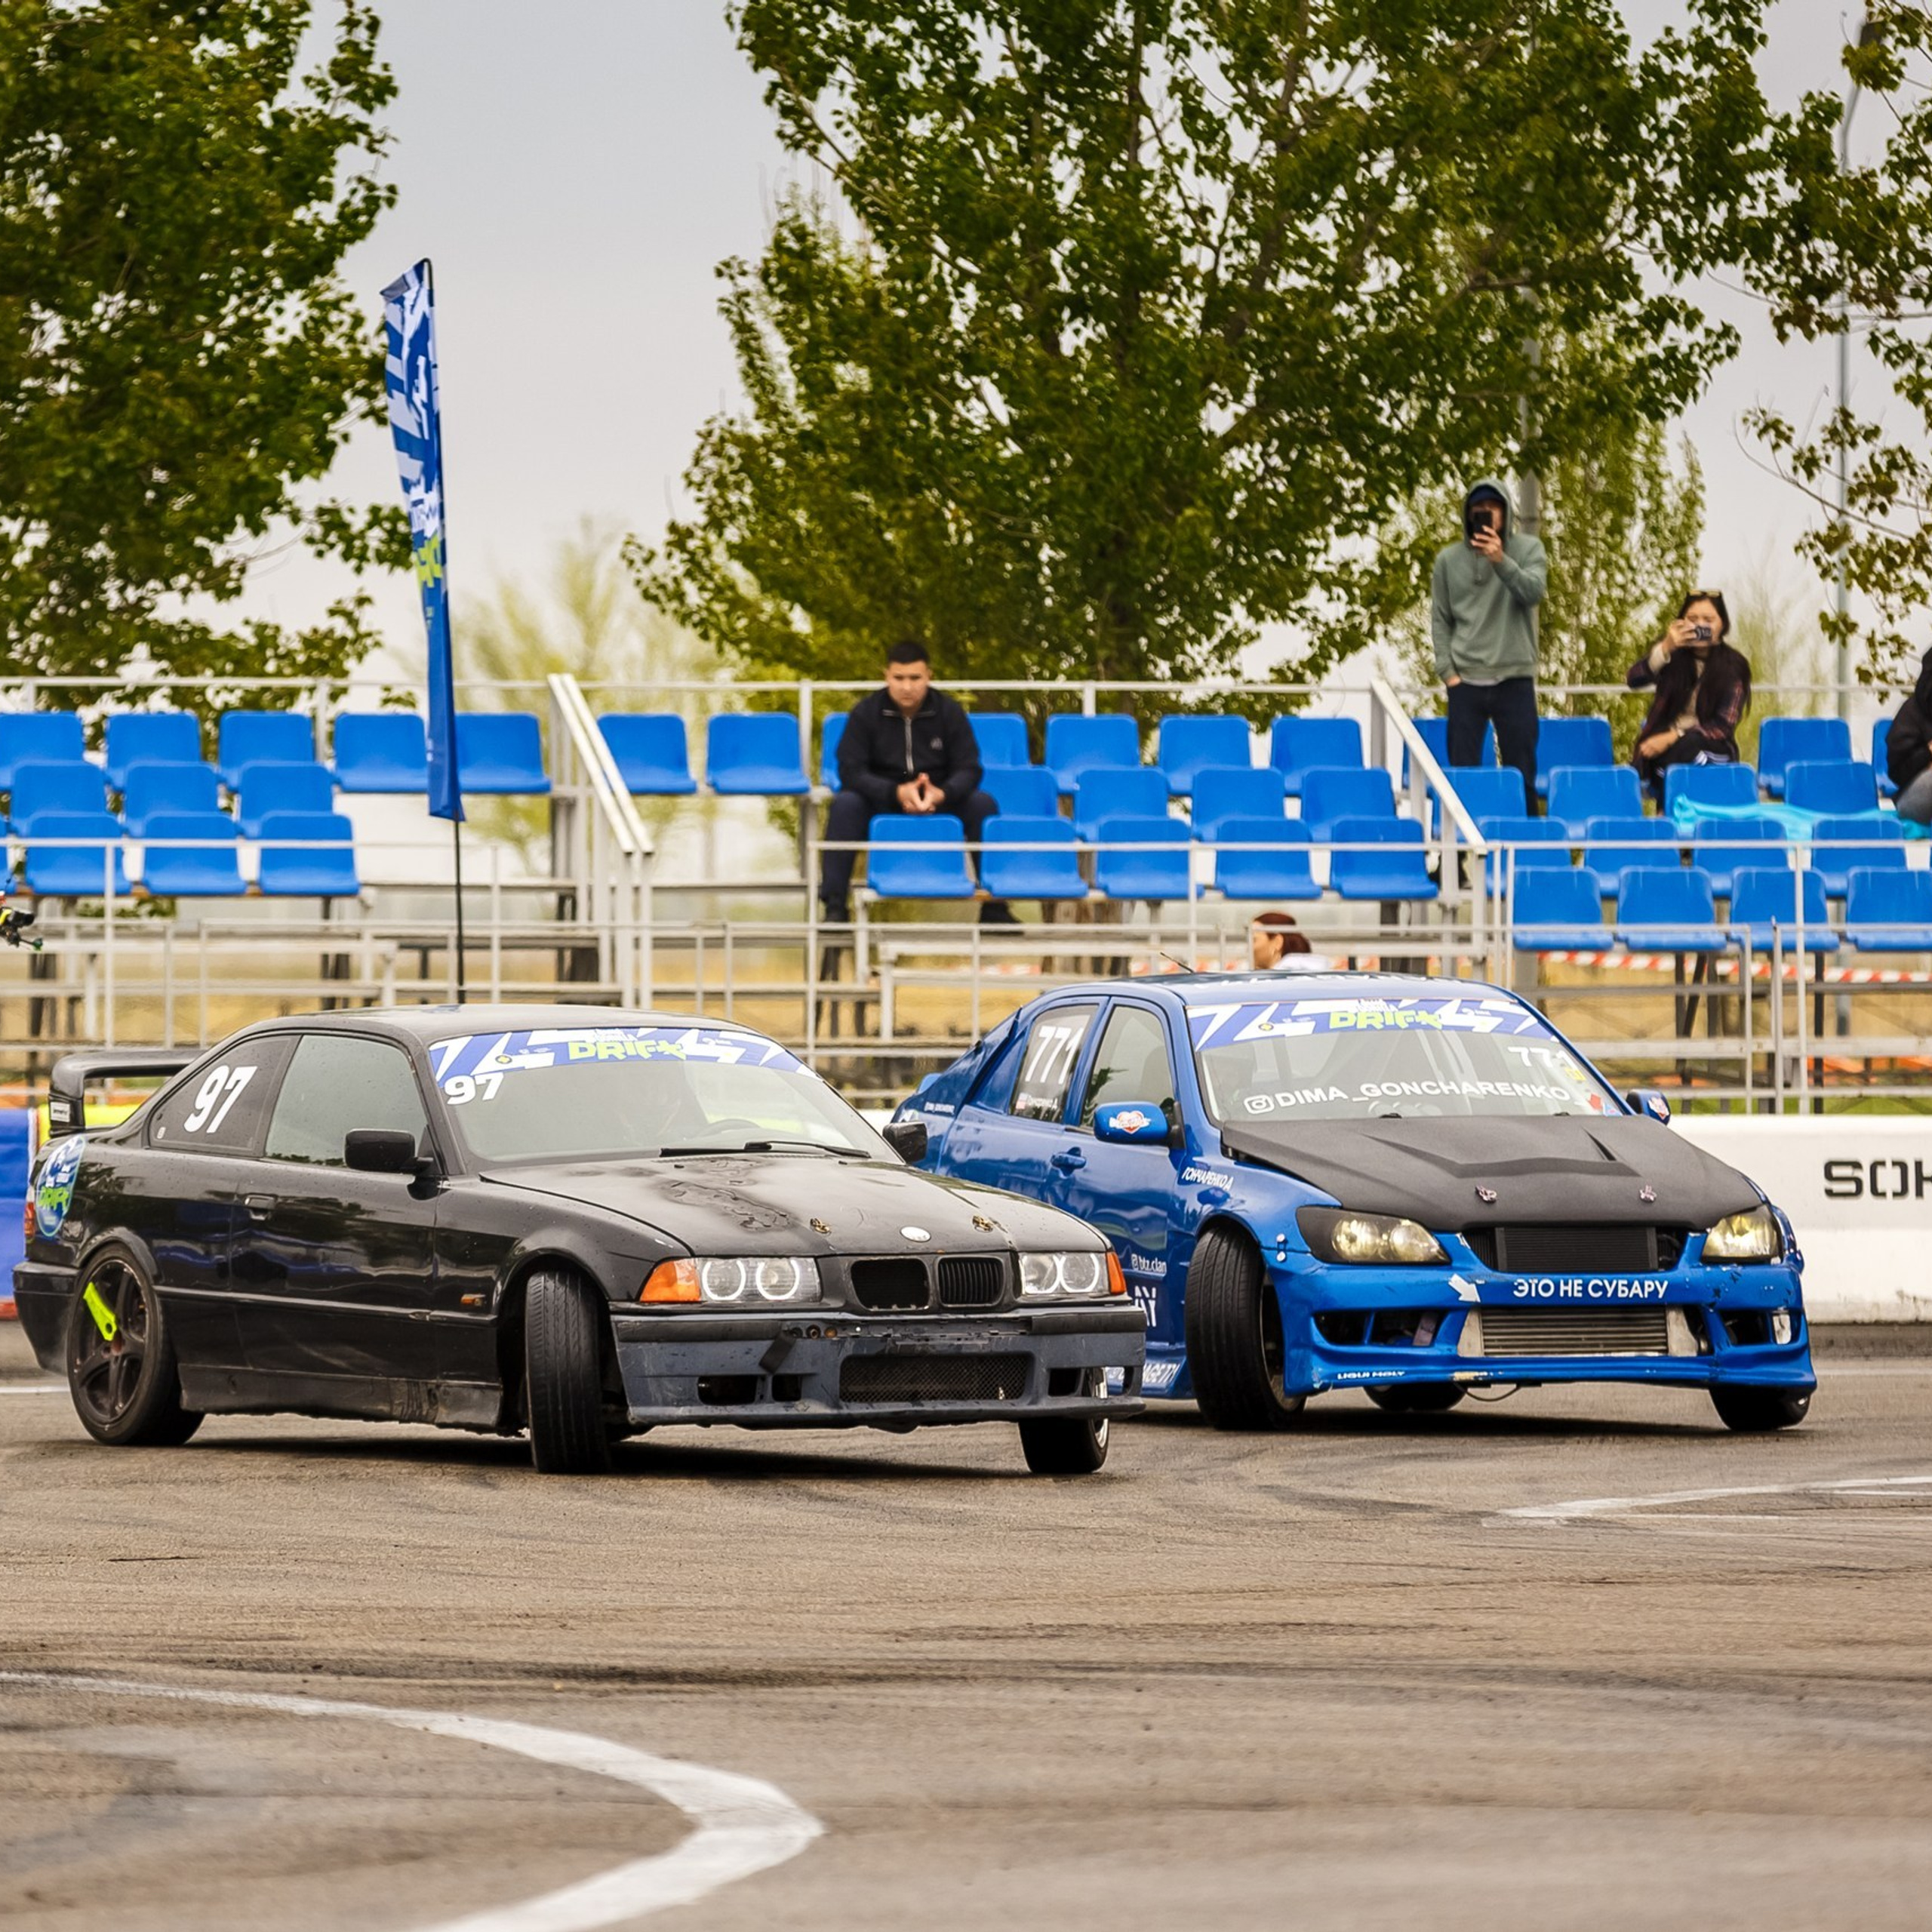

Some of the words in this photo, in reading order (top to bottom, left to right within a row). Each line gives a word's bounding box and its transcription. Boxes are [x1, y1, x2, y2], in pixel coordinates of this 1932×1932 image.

[1025, 1026, 1084, 1084] 771
[1507, 1047, 1581, 1072] 771
[183, 1065, 257, 1134] 97
[444, 1072, 504, 1105] 97
[1513, 1279, 1555, 1297] ЭТО
[1559, 1279, 1583, 1297] НЕ
[1587, 1279, 1669, 1298] СУБАРУ
[1372, 1370, 1405, 1378] MOLY
